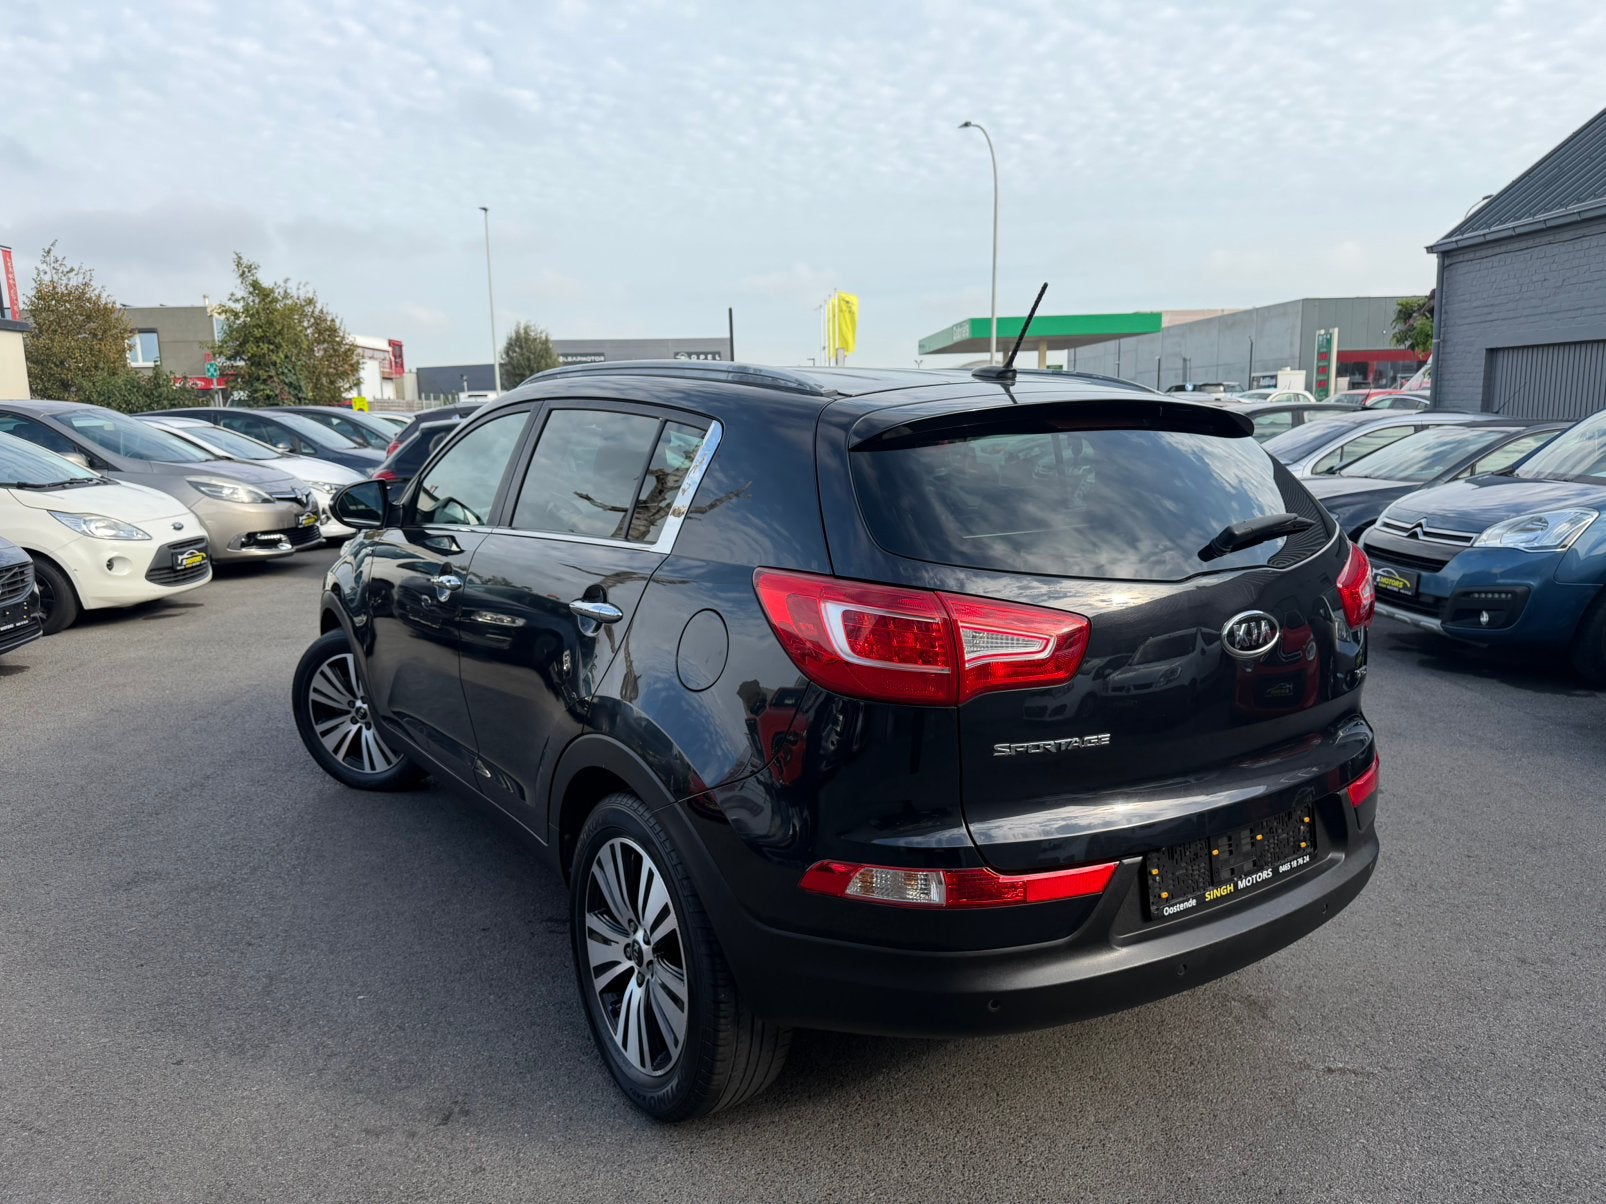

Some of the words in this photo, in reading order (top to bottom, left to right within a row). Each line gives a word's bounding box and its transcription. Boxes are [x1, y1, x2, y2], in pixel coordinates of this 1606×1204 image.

[1232, 620, 1272, 649] KIA
[993, 733, 1111, 757] SPORTAGE
[1163, 898, 1197, 916] Oostende
[1205, 883, 1234, 902] SINGH
[1237, 868, 1273, 890] MOTORS
